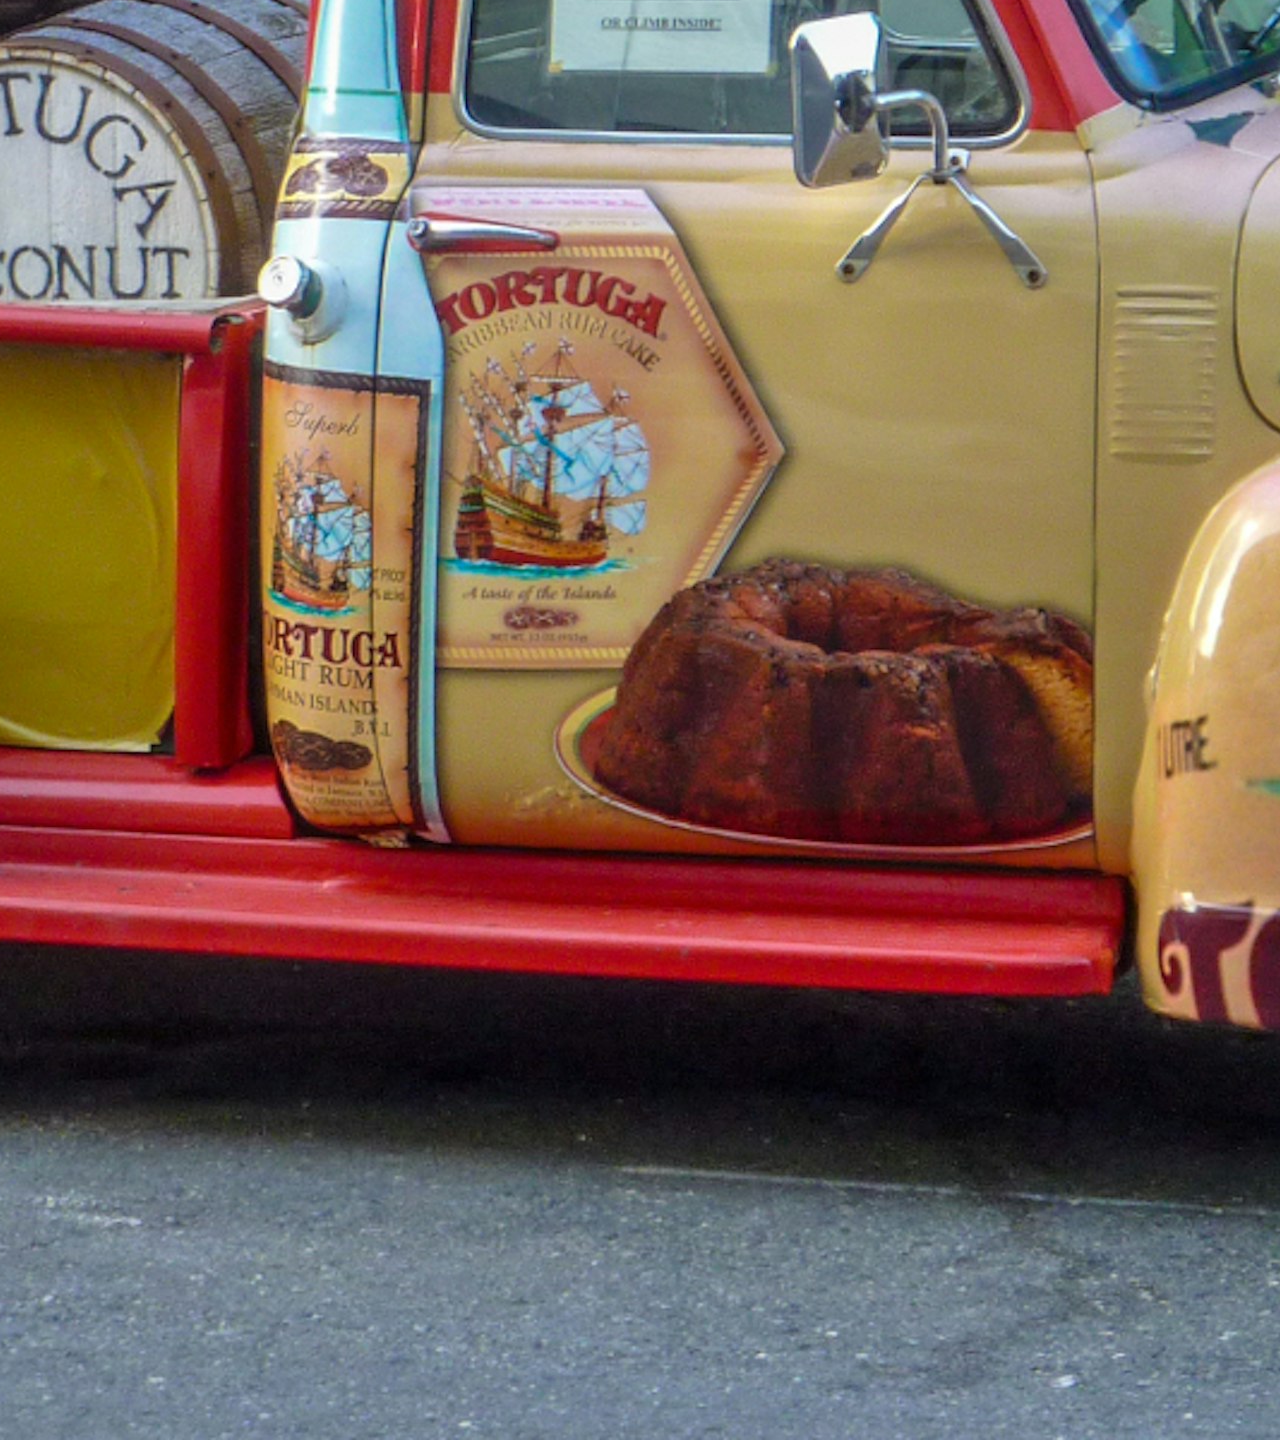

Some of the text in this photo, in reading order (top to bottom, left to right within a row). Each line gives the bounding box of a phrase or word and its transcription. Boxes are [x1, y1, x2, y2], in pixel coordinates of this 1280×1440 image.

[600, 17, 622, 30] OR
[625, 17, 669, 30] CLIMB
[435, 265, 668, 339] TORTUGA
[559, 310, 608, 340] RUM
[611, 327, 661, 373] CAKE
[284, 400, 361, 440] Superb
[461, 584, 617, 604] A taste of the Islands
[318, 664, 374, 691] RUM
